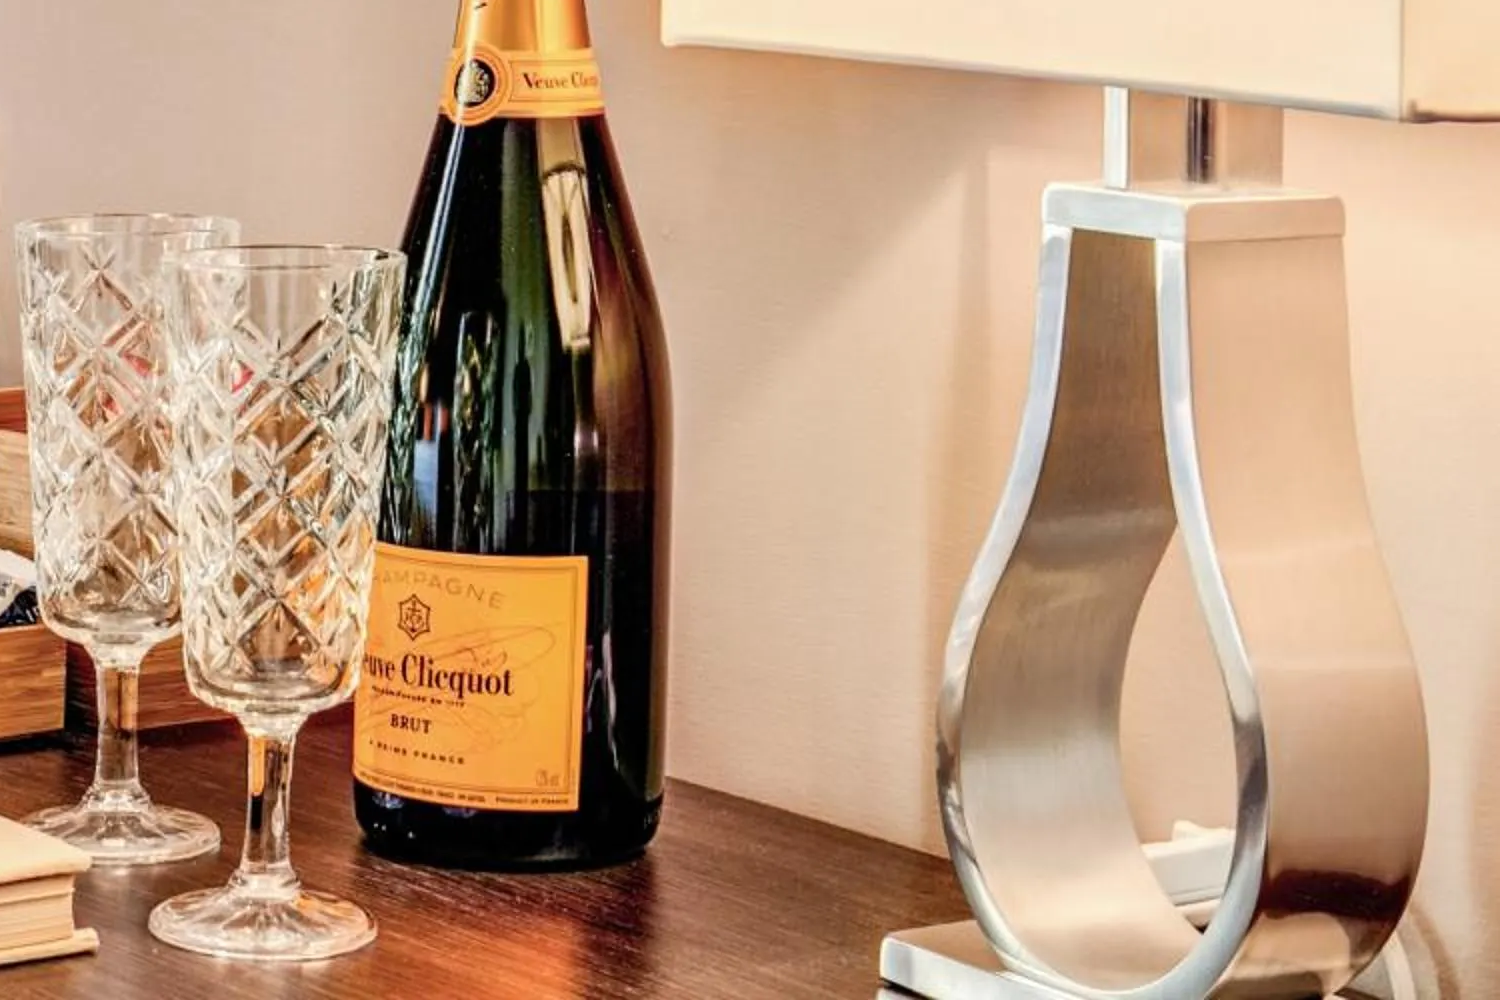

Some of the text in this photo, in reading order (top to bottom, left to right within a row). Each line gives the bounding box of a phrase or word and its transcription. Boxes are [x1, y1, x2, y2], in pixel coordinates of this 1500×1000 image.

[522, 71, 569, 90] Veuve
[373, 569, 509, 610] AMPAGNE
[363, 652, 395, 681] euve
[400, 653, 514, 699] Clicquot
[390, 713, 432, 734] BRUT
